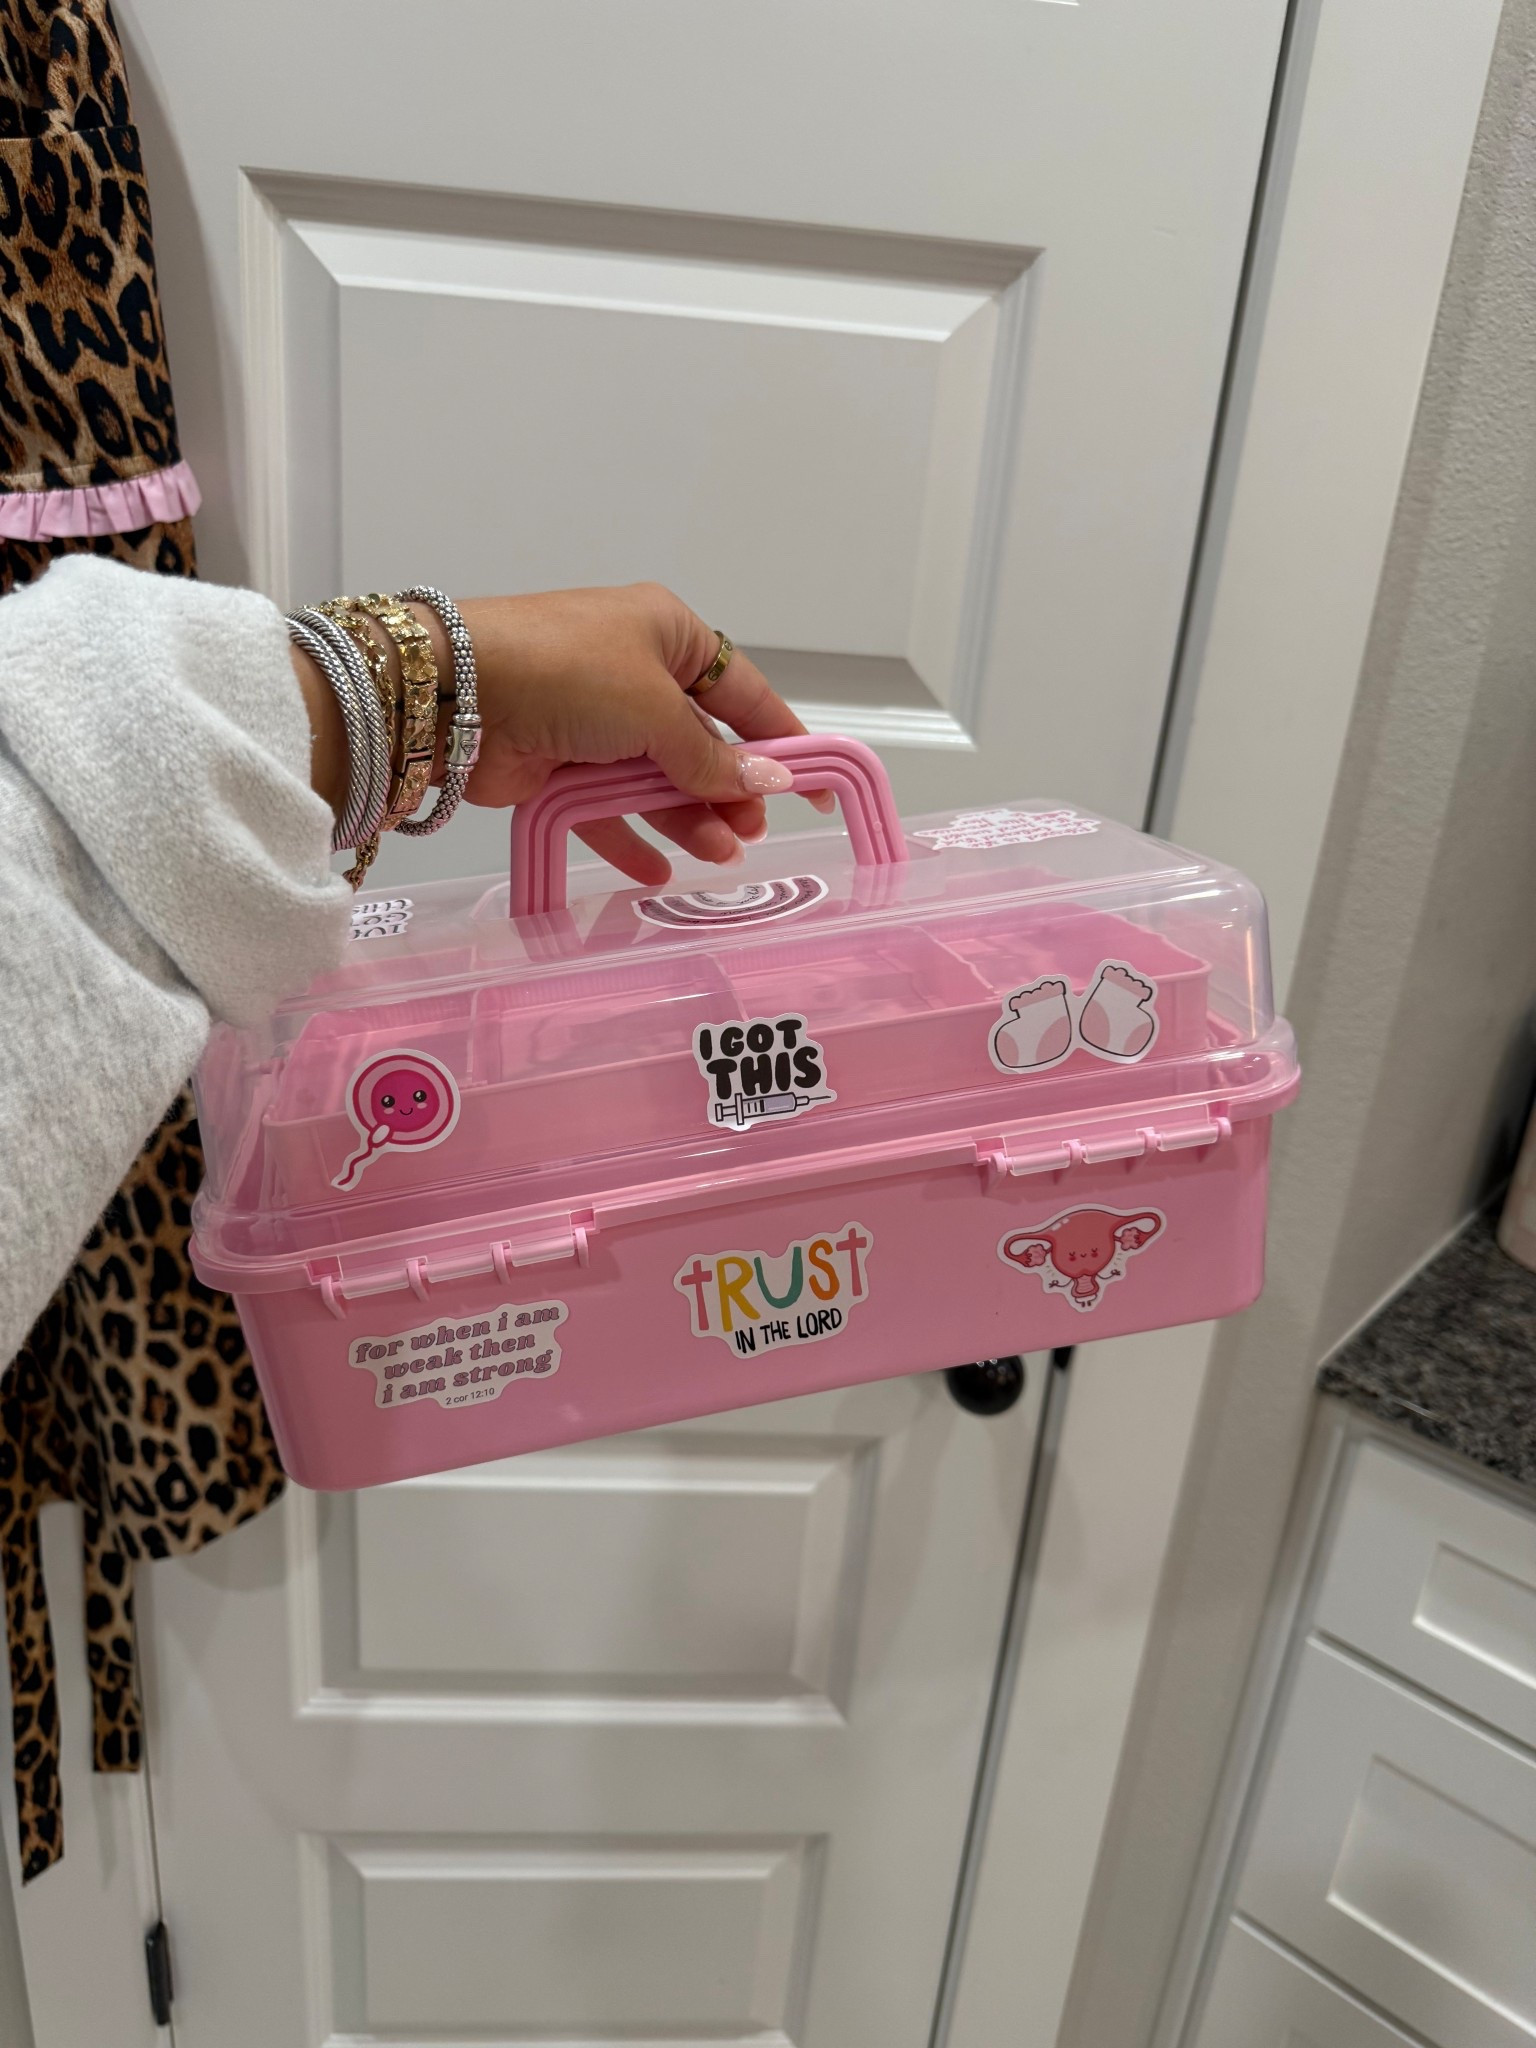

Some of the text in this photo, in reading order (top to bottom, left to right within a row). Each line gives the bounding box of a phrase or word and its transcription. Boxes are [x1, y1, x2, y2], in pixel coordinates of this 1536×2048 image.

[699, 1019, 802, 1061] I GOT
[706, 1045, 822, 1100] THIS
[355, 1306, 560, 1364] for when i am
[735, 1307, 843, 1353] IN THE LORD
[382, 1349, 555, 1405] i am strong
[384, 1333, 536, 1380] weak then
[445, 1387, 496, 1406] 2 cor 12:10
